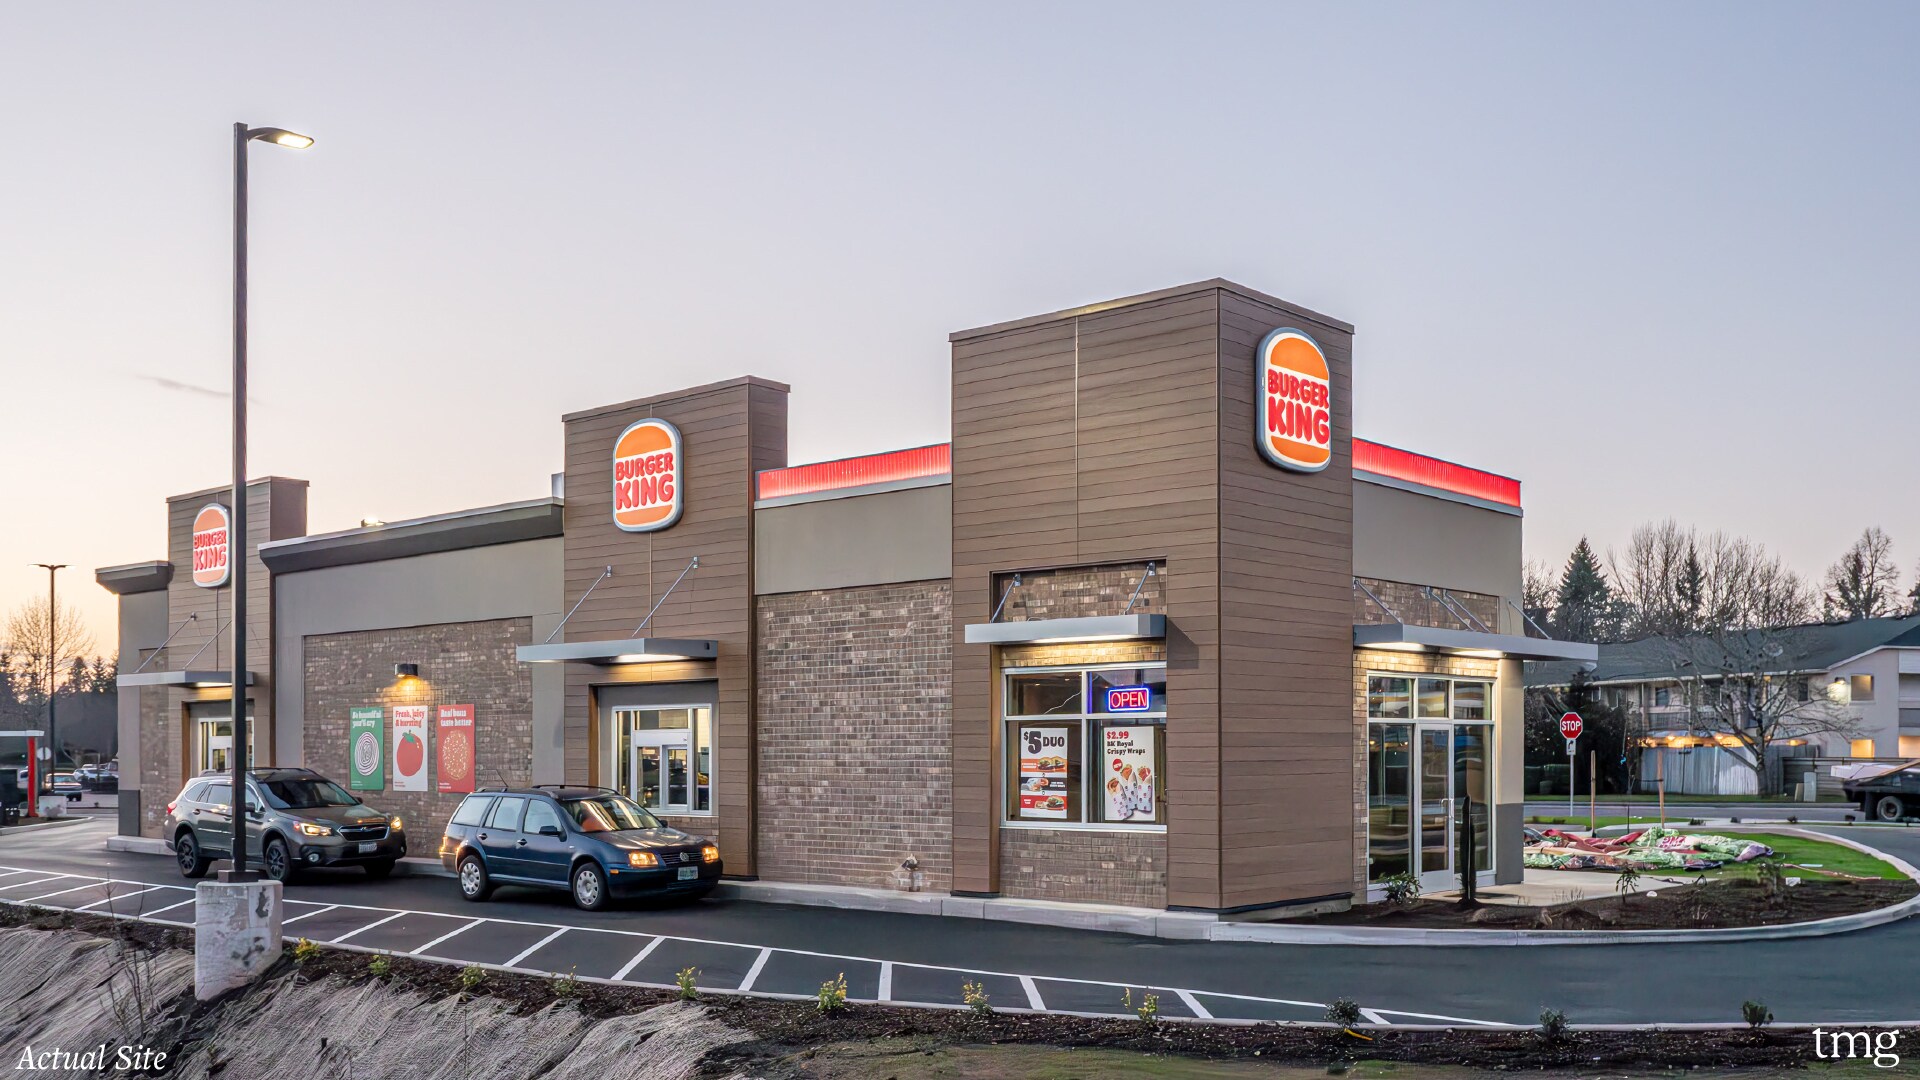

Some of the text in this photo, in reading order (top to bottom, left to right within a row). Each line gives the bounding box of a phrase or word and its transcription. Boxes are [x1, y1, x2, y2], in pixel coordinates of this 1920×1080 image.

[1268, 368, 1329, 409] BURGER
[1268, 395, 1330, 445] KING
[615, 452, 674, 481] BURGER
[615, 473, 674, 510] KING
[193, 530, 227, 549] BURGER
[193, 545, 227, 571] KING
[1110, 691, 1147, 708] OPEN
[1561, 721, 1581, 731] STOP
[1042, 737, 1065, 747] DUO
[1106, 731, 1129, 740] $2.99
[1117, 740, 1134, 748] Royal
[1107, 748, 1127, 756] Crispy
